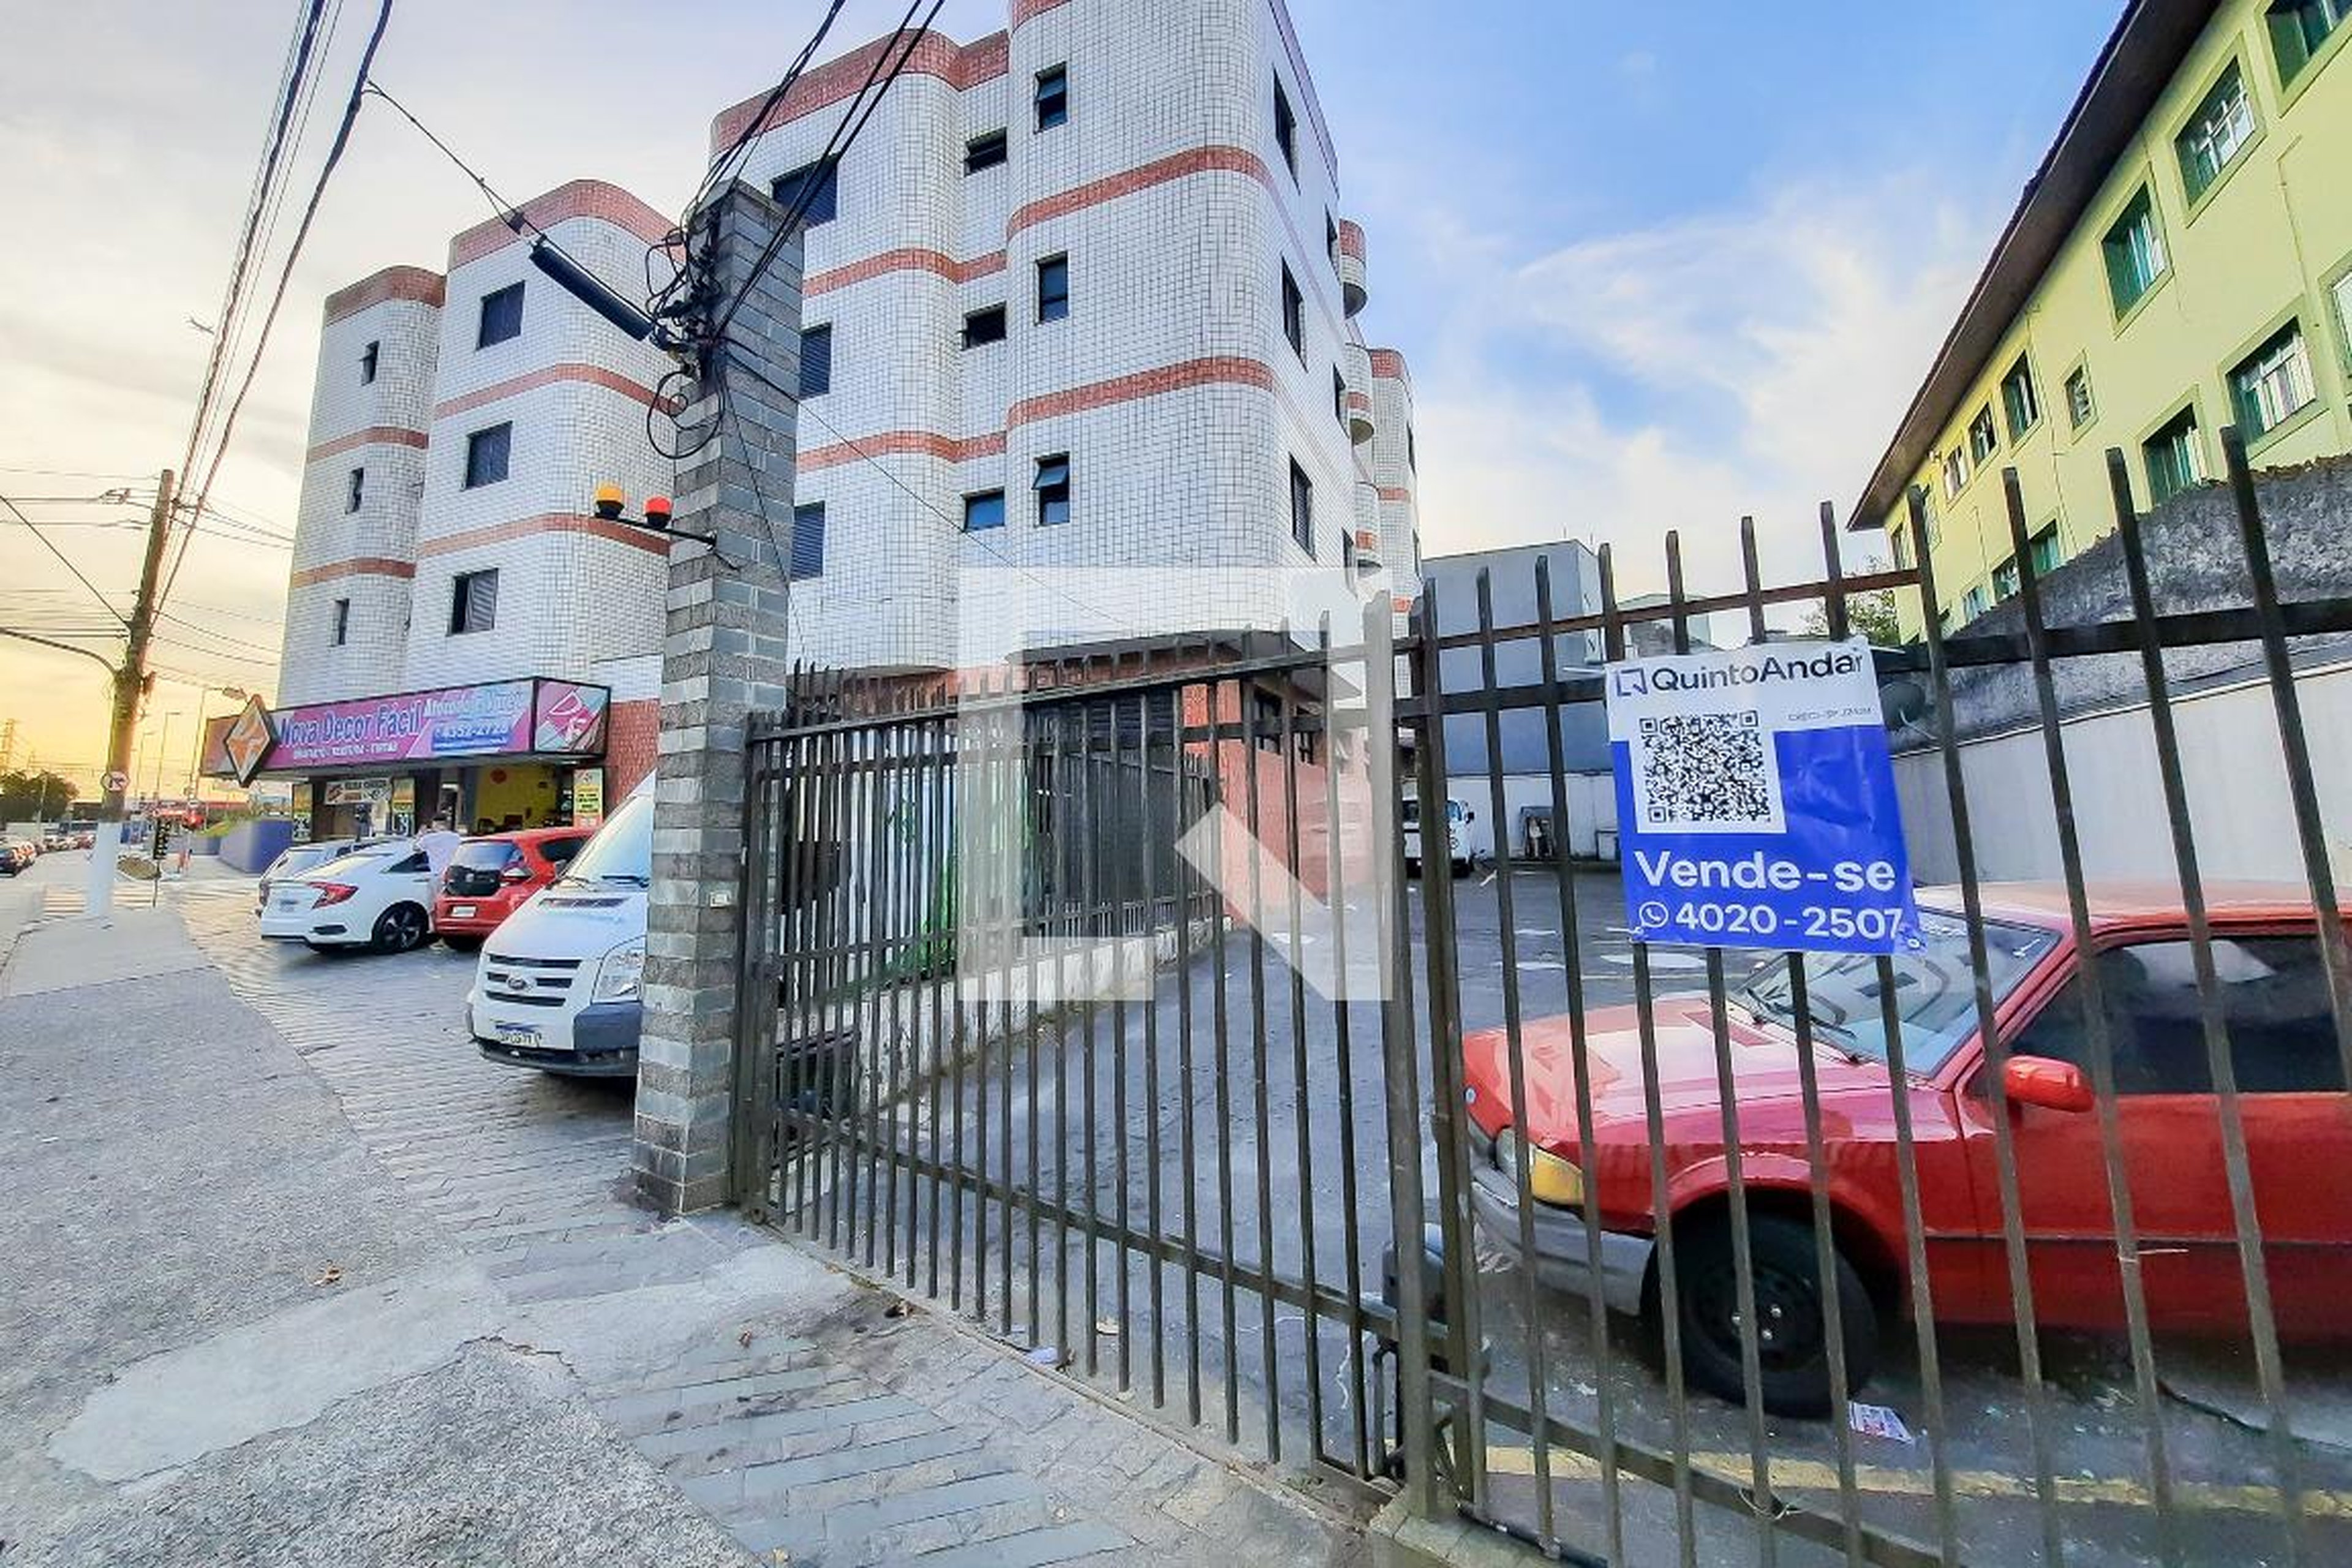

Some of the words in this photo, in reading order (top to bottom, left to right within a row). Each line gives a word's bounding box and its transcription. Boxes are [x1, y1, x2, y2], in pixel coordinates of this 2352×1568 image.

[1652, 651, 1863, 691] QuintoAndar
[322, 711, 372, 743] Decor
[375, 701, 424, 739] Fácil
[1634, 850, 1896, 891] Vende-se
[1675, 902, 1903, 940] 4020-2507
